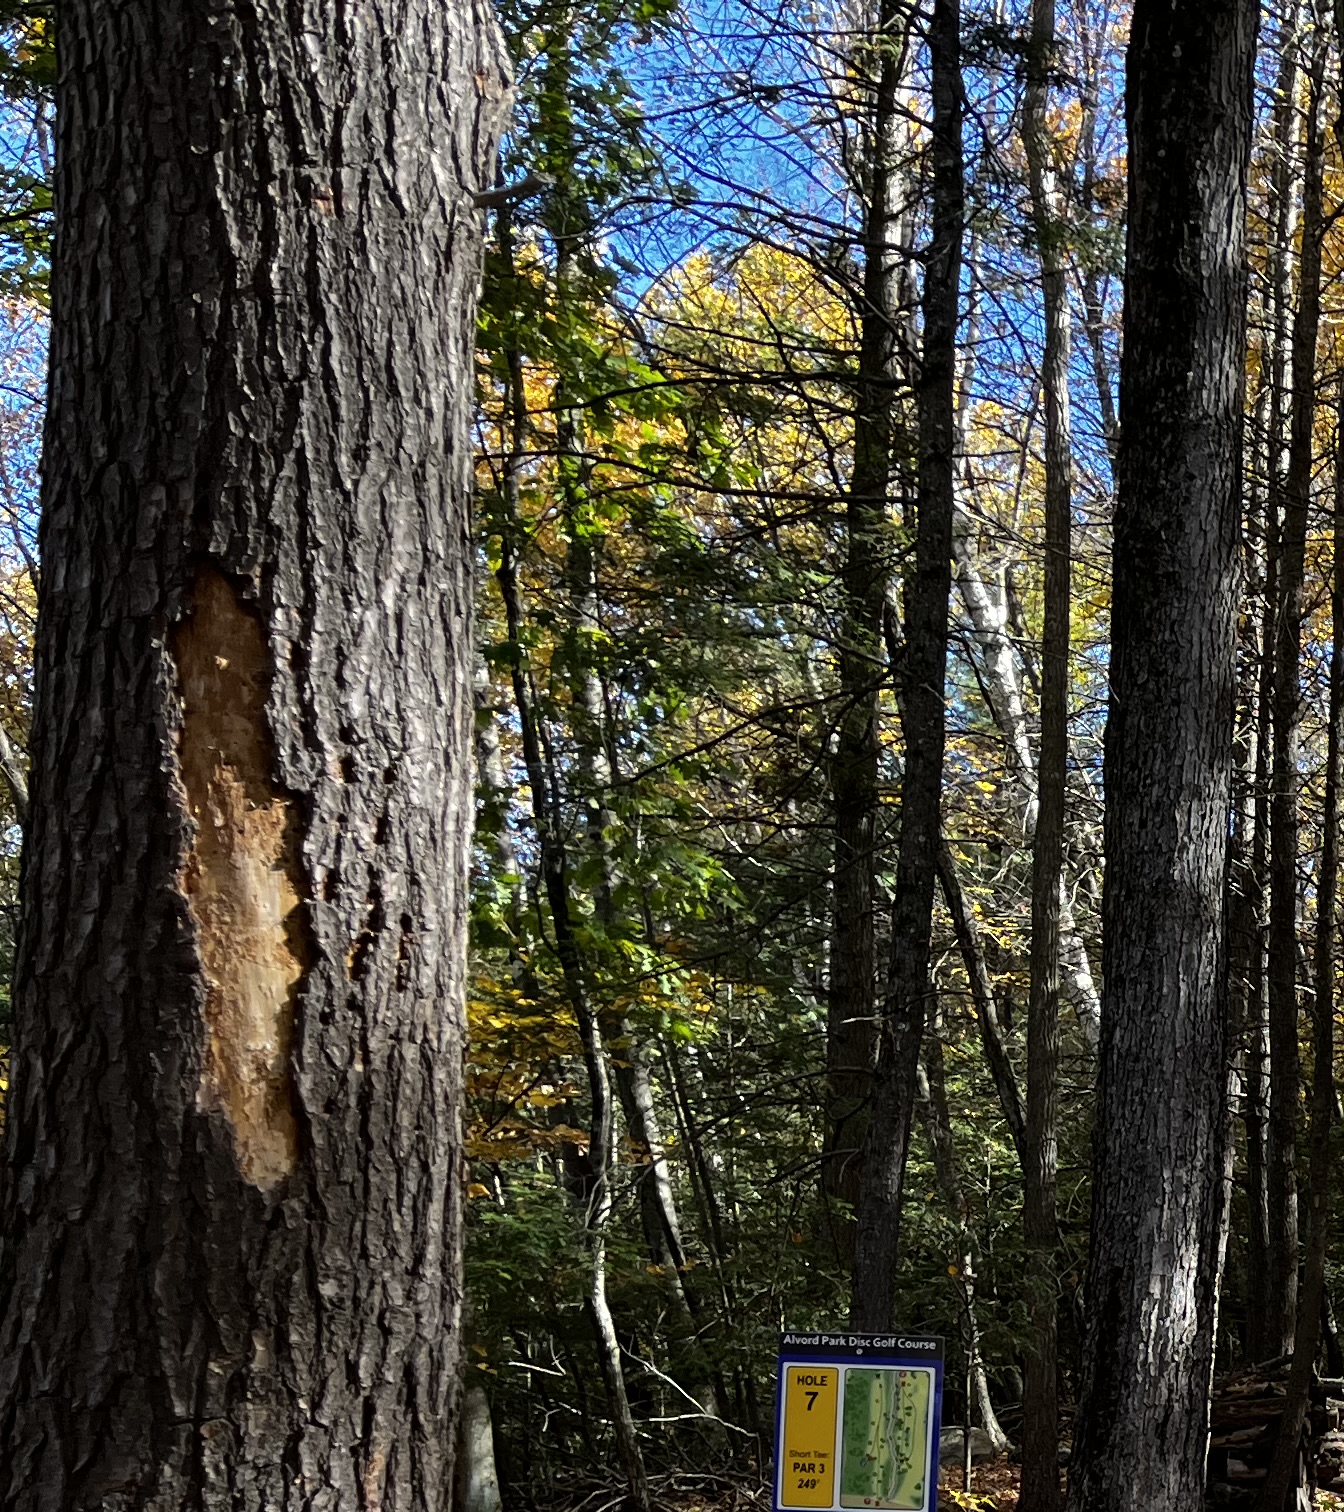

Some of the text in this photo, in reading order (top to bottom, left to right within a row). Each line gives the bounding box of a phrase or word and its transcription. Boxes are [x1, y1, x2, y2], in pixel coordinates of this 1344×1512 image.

[783, 1334, 937, 1350] Alvord Park Disc Golf Course
[797, 1374, 828, 1386] HOLE
[805, 1391, 819, 1411] 7
[788, 1449, 812, 1459] Short
[793, 1462, 825, 1474] PAR 3
